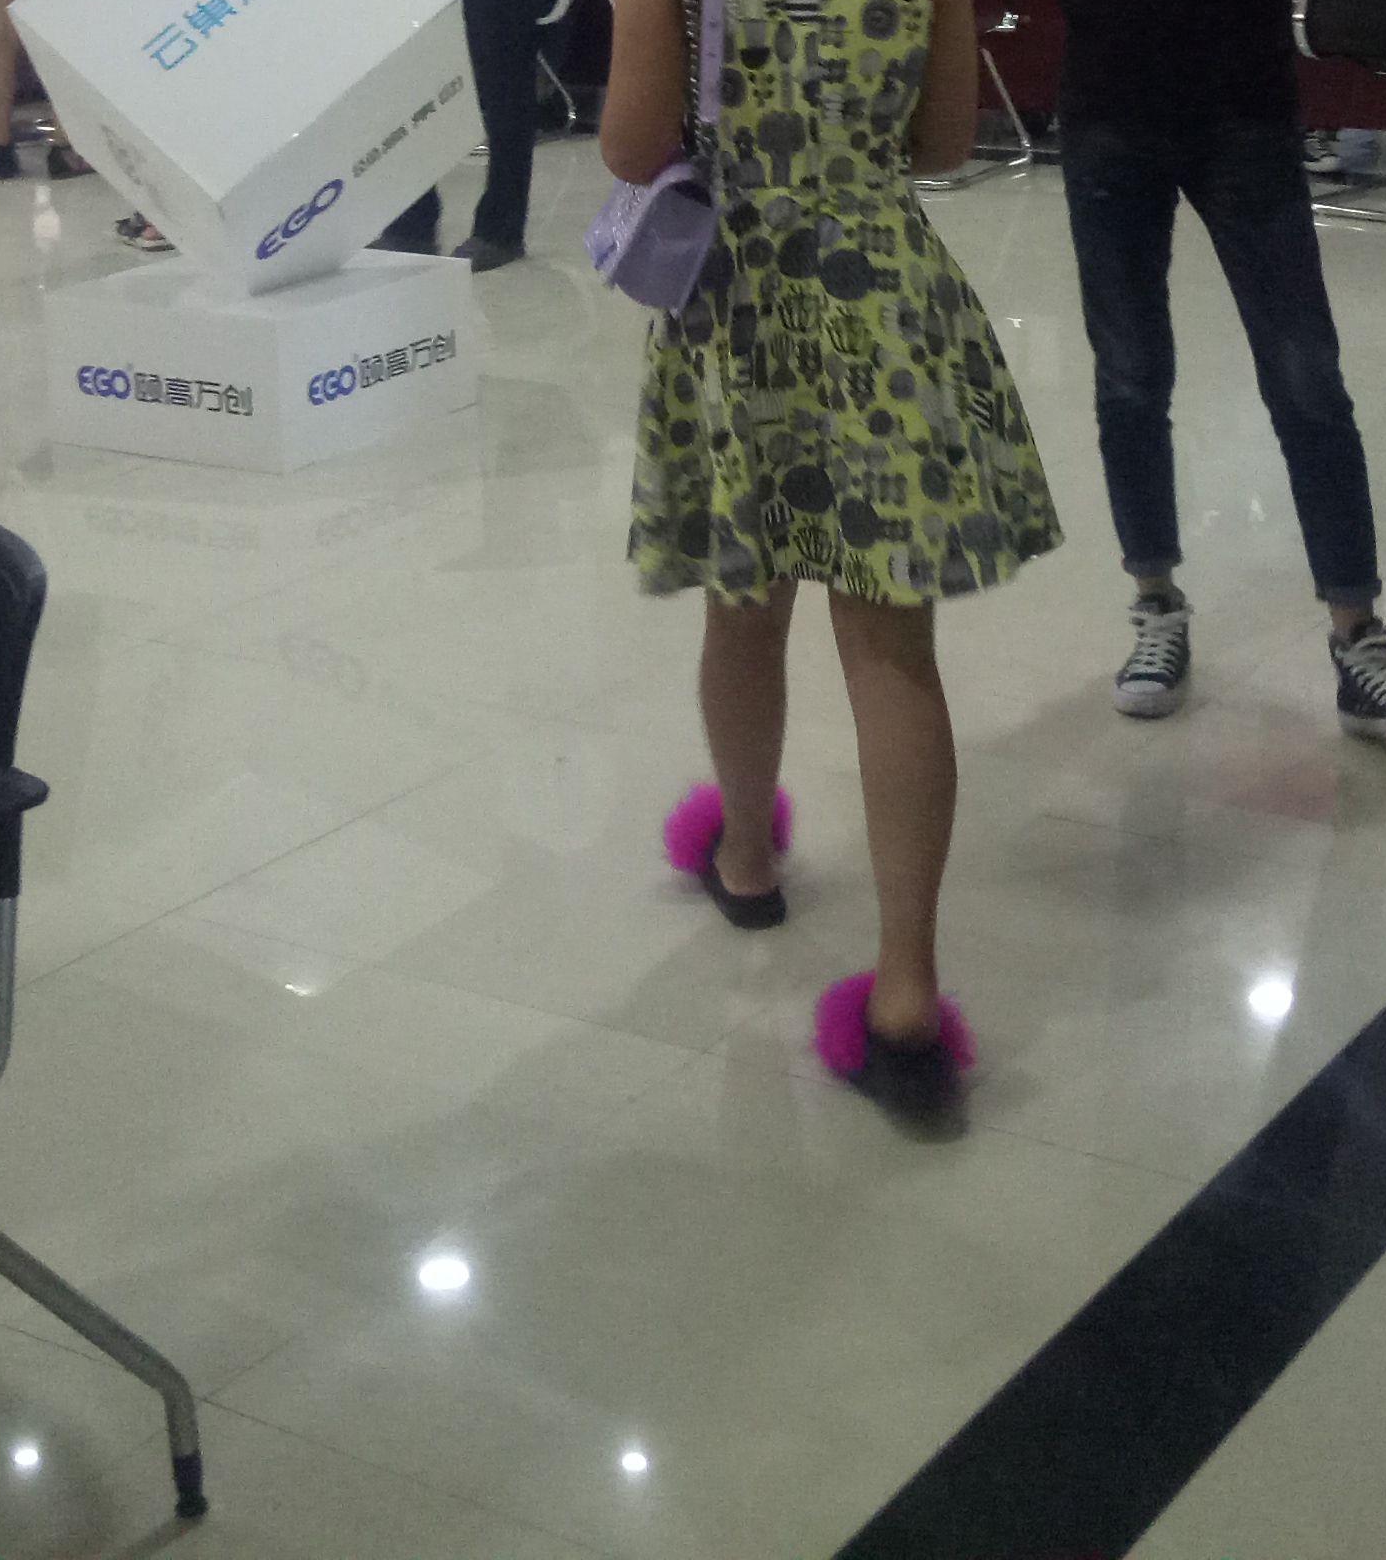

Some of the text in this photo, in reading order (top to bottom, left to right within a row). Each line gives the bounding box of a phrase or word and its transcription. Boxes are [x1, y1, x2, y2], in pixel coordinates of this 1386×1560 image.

[256, 178, 344, 260] EGO
[77, 365, 131, 399] EGO
[307, 364, 357, 405] EGO
